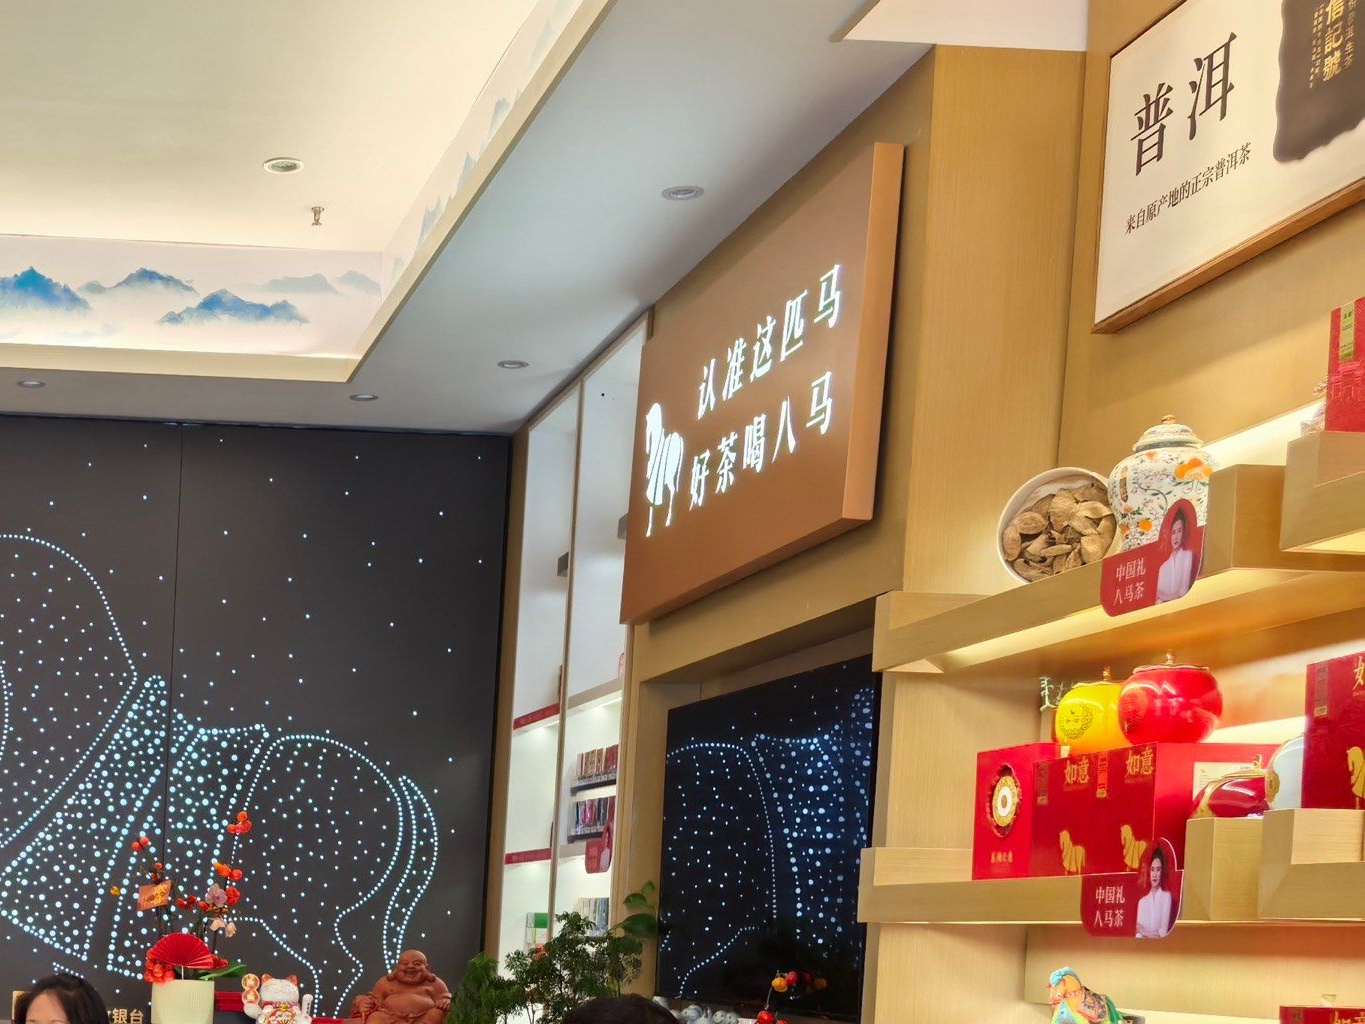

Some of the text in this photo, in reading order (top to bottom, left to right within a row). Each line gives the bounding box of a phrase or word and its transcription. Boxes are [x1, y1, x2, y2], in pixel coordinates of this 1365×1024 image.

[1130, 32, 1237, 177] 普洱
[1124, 142, 1251, 237] 来自原产地的正宗普洱茶
[697, 264, 842, 420] 认准这匹马
[689, 371, 834, 511] 好茶喝八马
[1115, 555, 1147, 580] 中国礼
[1112, 581, 1145, 606] 八马茶
[1063, 757, 1090, 785] 如意
[1125, 749, 1154, 777] 如意
[1094, 884, 1126, 905] 中国礼
[1092, 908, 1125, 929] 八马茶
